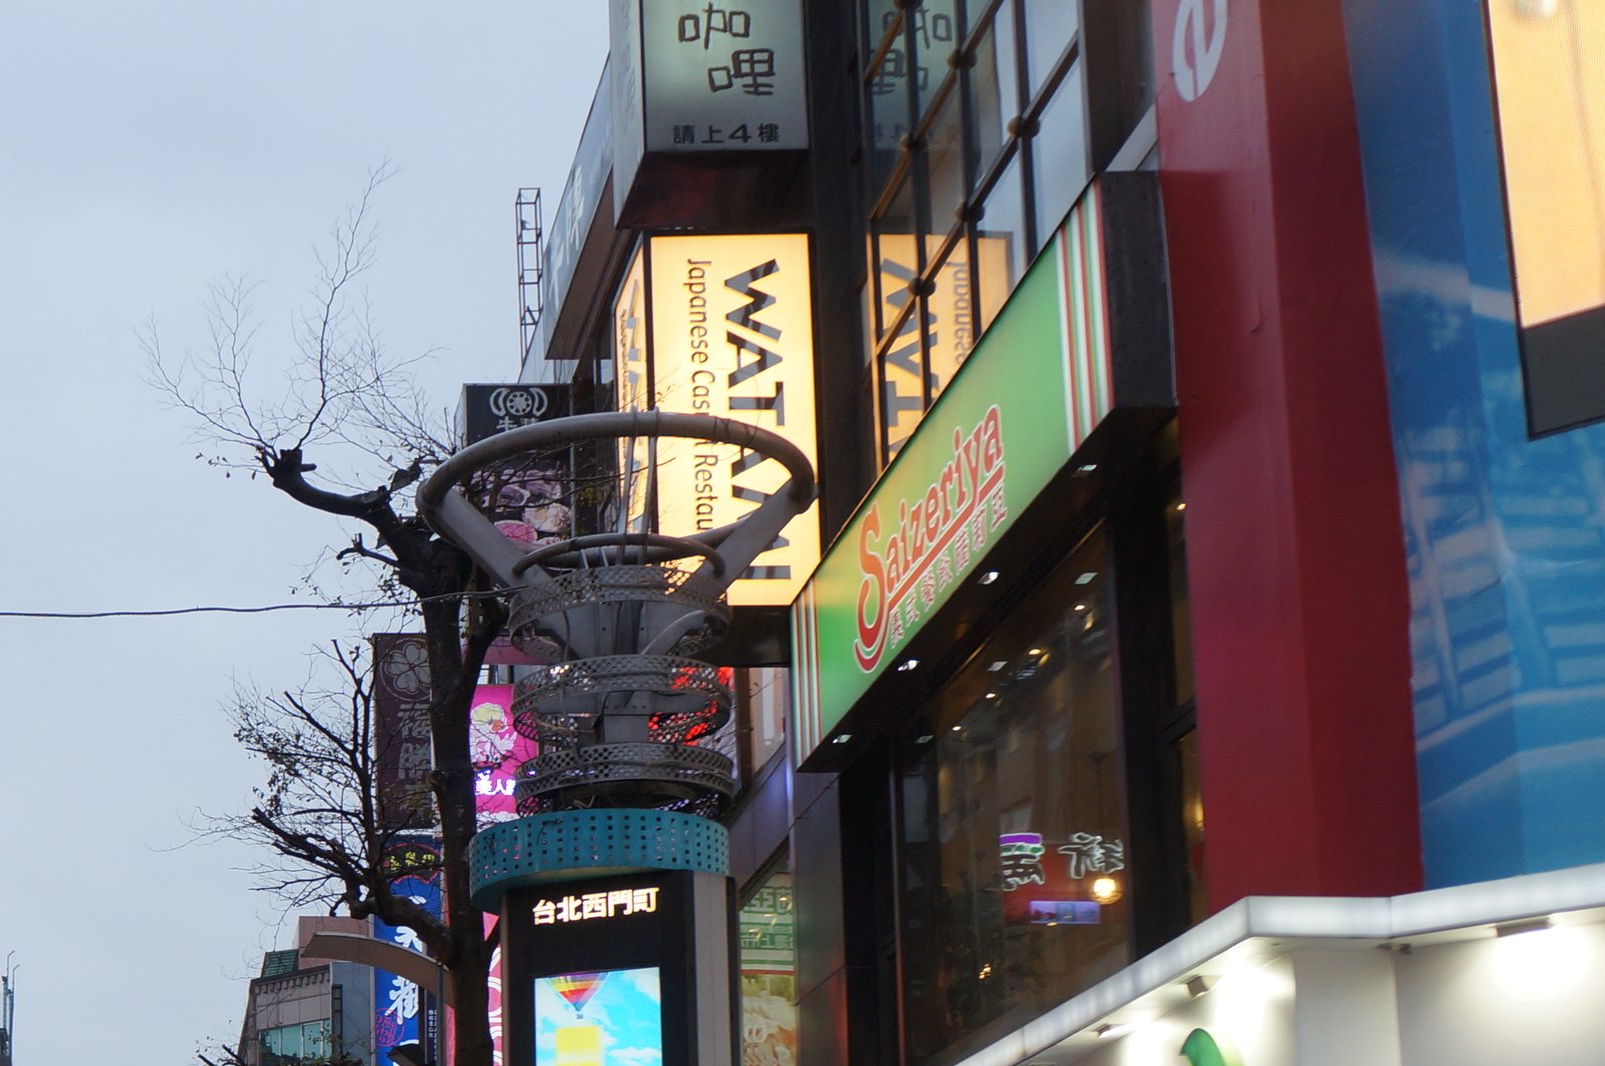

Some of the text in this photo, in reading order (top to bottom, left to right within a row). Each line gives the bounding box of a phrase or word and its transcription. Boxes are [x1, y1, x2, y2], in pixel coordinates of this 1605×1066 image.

[677, 2, 775, 96] 咖哩
[673, 123, 781, 145] 請上4樓
[682, 258, 711, 358] Japanese
[853, 403, 1006, 674] Saizeriya
[532, 887, 660, 927] 台北西門町
